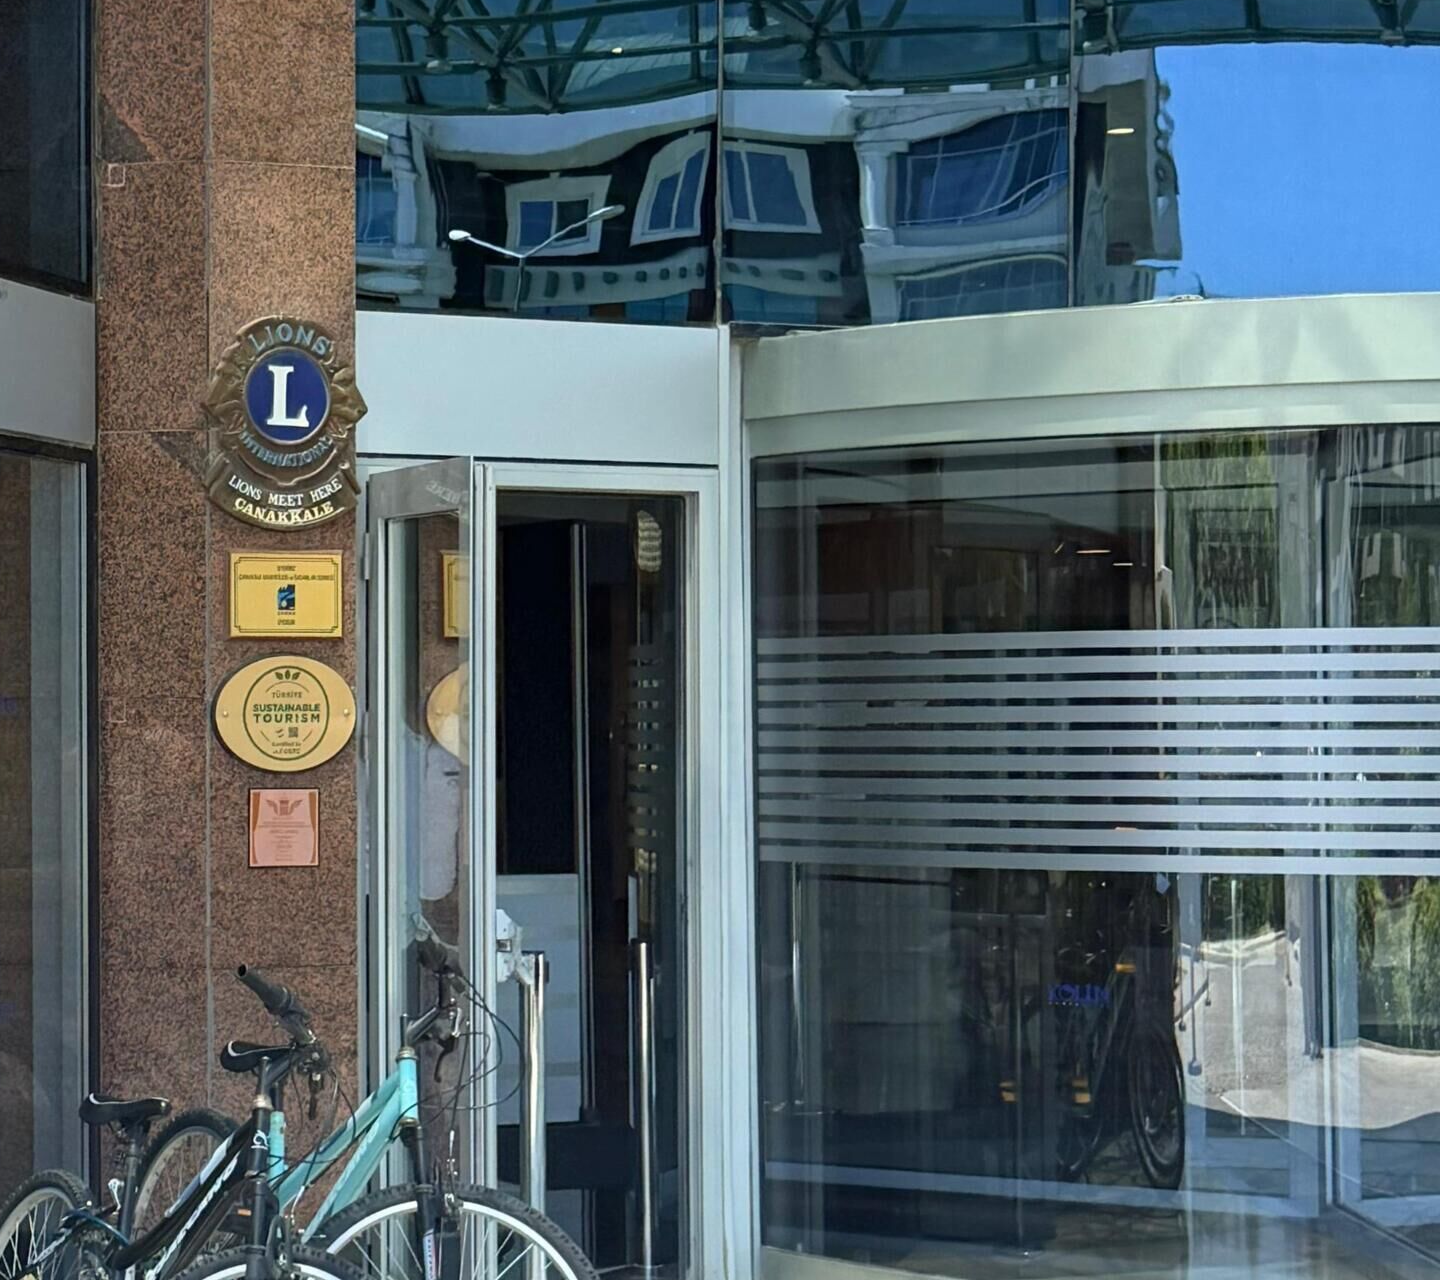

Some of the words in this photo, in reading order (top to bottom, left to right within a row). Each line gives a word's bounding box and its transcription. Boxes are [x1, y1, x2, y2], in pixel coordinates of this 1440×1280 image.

[248, 322, 330, 355] LIONS
[266, 364, 309, 427] L
[239, 429, 335, 467] INTERNATIONAL
[228, 474, 262, 501] LIONS
[268, 492, 303, 507] MEET
[310, 478, 343, 502] HERE
[252, 703, 321, 712] SUSTAINABLE
[252, 713, 320, 724] TOURISM
